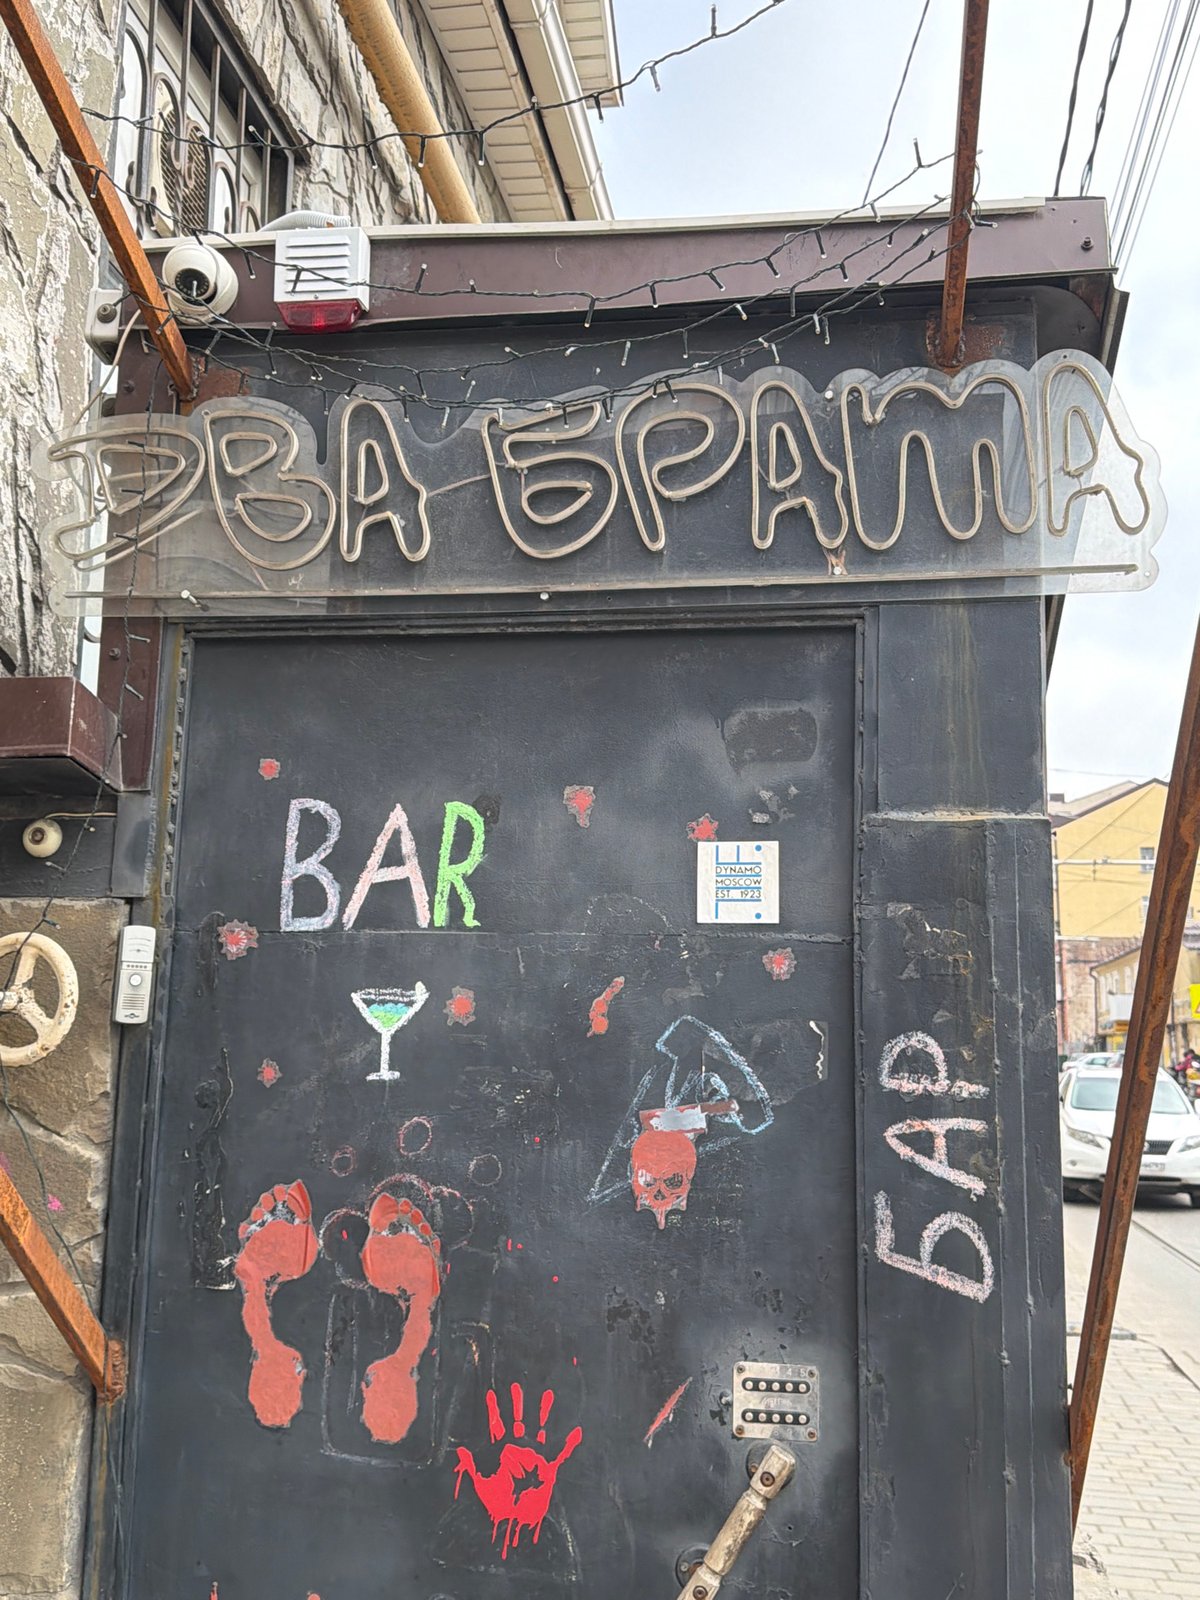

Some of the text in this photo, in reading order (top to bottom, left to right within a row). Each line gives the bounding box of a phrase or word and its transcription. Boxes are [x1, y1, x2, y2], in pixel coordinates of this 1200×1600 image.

[280, 798, 485, 932] BAR
[715, 865, 762, 874] DYNAMO
[715, 878, 762, 887] MOSCOW
[740, 890, 761, 898] 1923
[874, 1031, 995, 1304] БАР
[800, 1368, 806, 1377] 5
